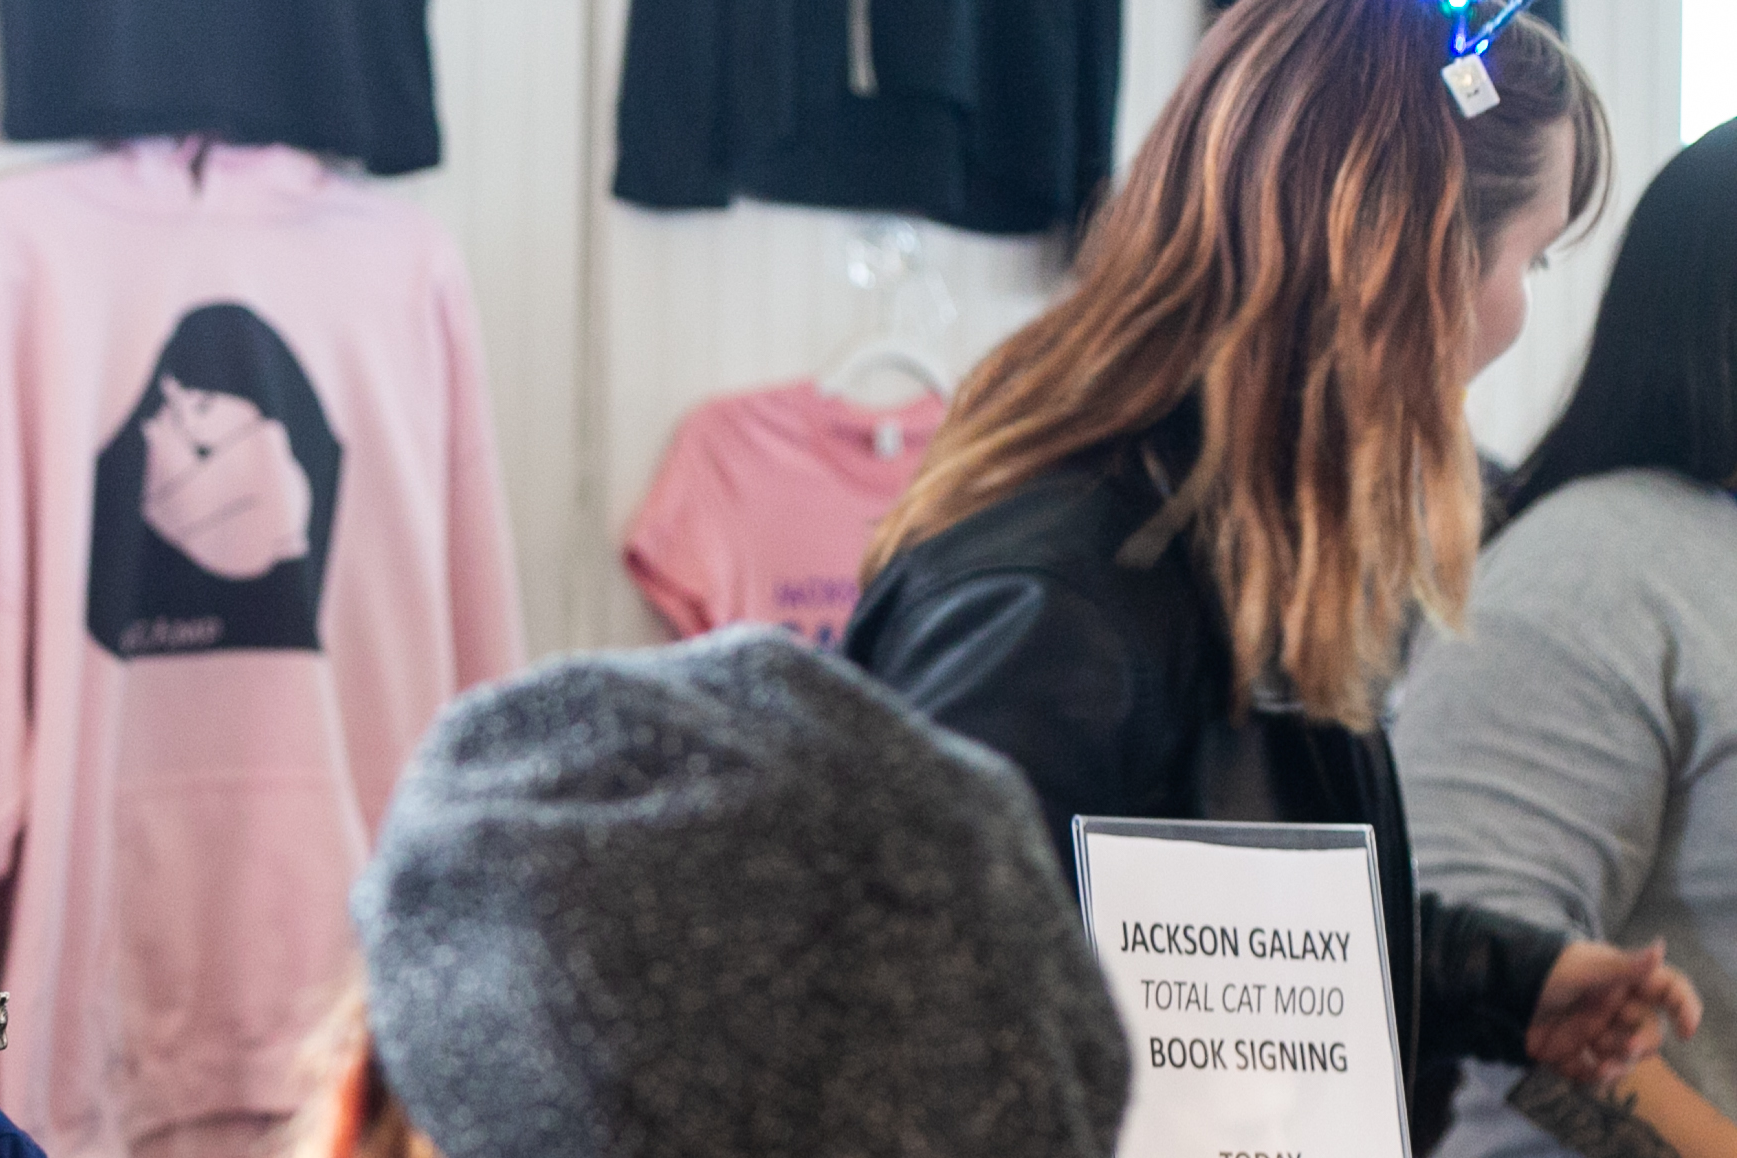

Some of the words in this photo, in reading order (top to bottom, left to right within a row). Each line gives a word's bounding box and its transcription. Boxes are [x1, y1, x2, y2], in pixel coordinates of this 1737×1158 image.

[1120, 921, 1240, 958] JACKSON
[1249, 927, 1351, 963] GALAXY
[1141, 979, 1214, 1012] TOTAL
[1222, 983, 1267, 1014] CAT
[1274, 986, 1345, 1016] MOJO
[1149, 1037, 1228, 1070] BOOK
[1234, 1039, 1348, 1073] SIGNING
